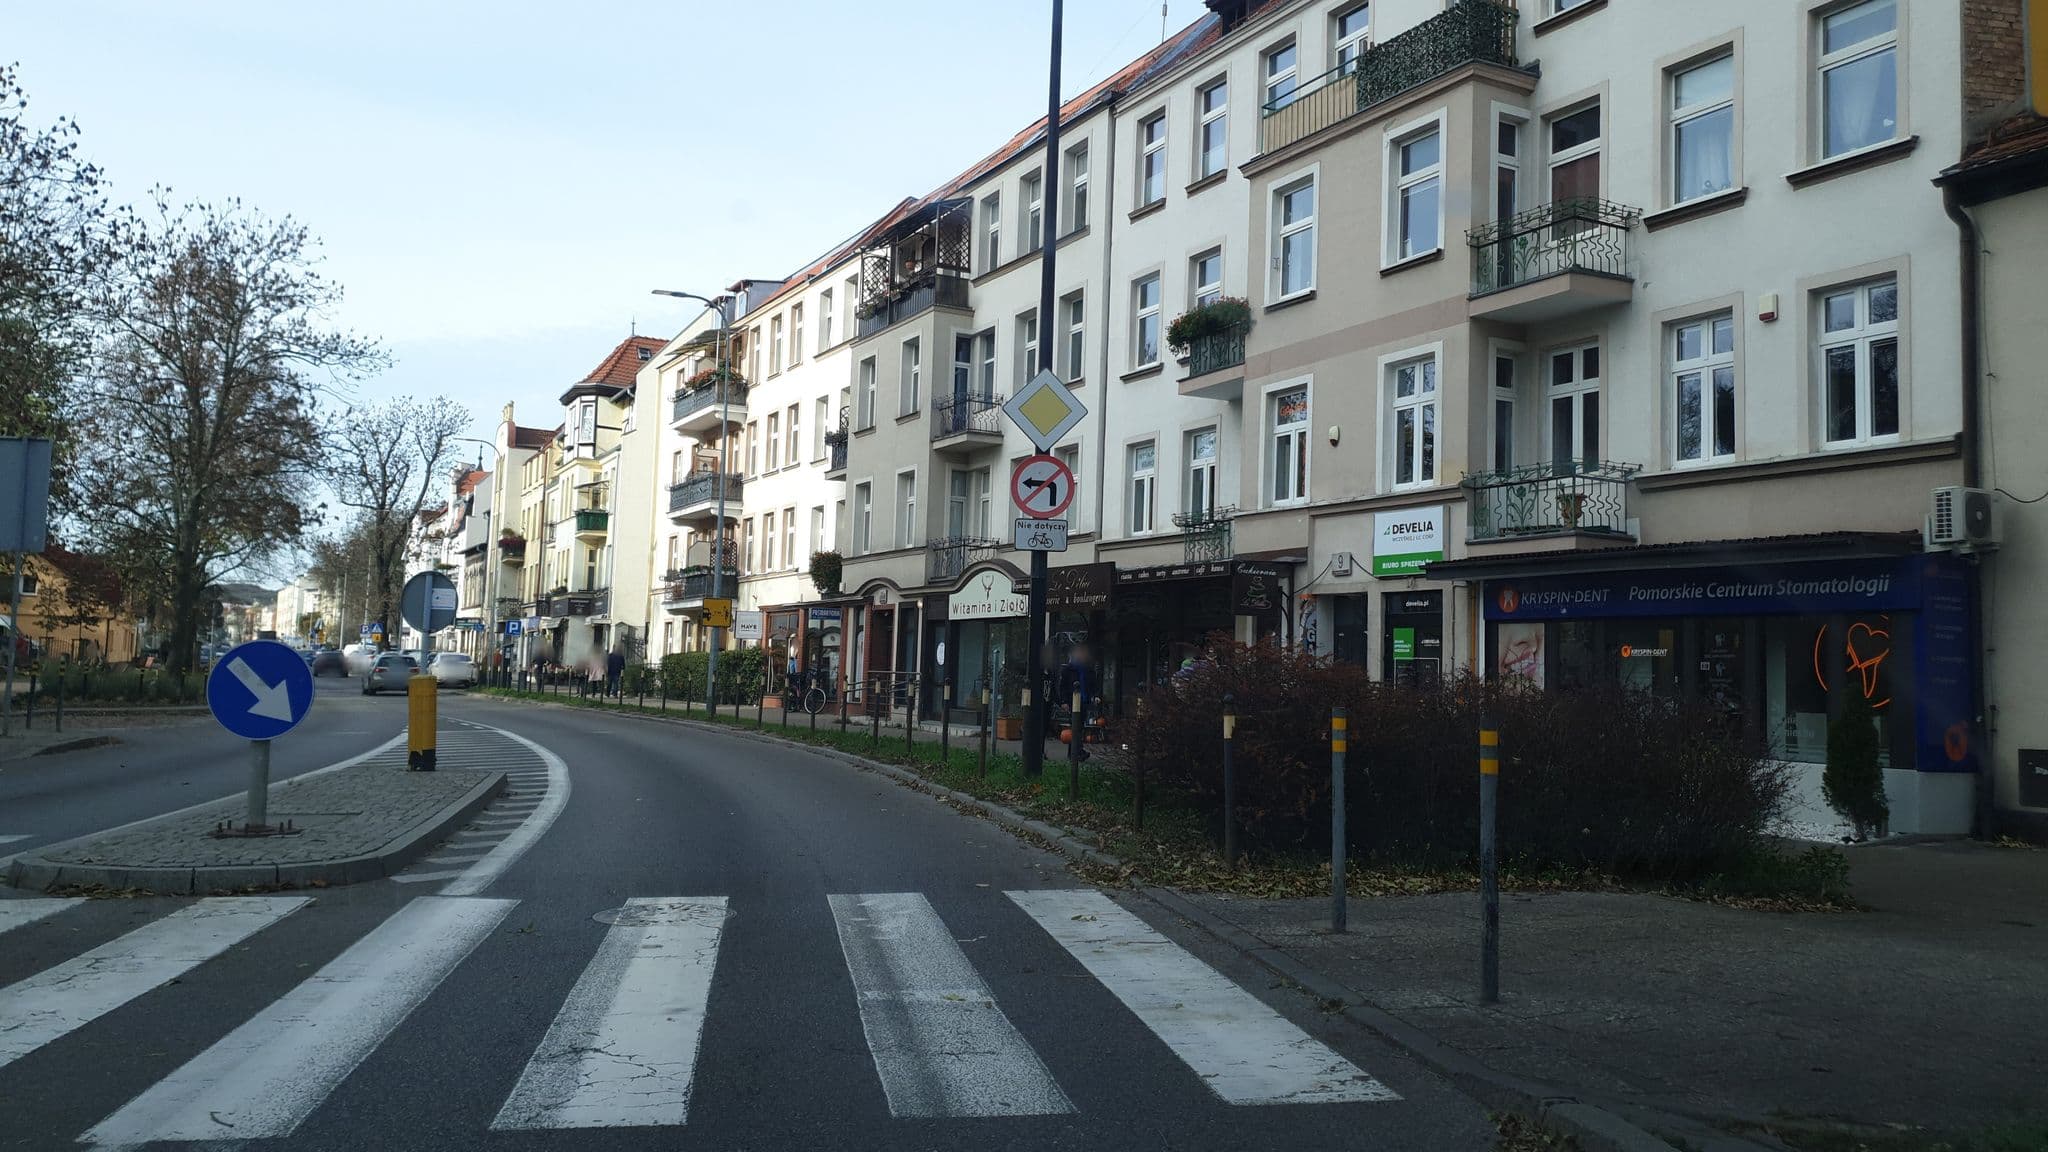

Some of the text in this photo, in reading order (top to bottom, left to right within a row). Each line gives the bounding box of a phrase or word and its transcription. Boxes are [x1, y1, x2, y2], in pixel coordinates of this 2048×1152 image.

[1017, 521, 1066, 532] Nie dotyczy
[1391, 521, 1434, 535] DEVELIA
[1338, 554, 1344, 569] 9
[1520, 574, 1890, 605] KRYSPIN-DENT Pomorskie Centrum Stomatologii
[952, 602, 992, 615] Witamina
[509, 621, 519, 633] P
